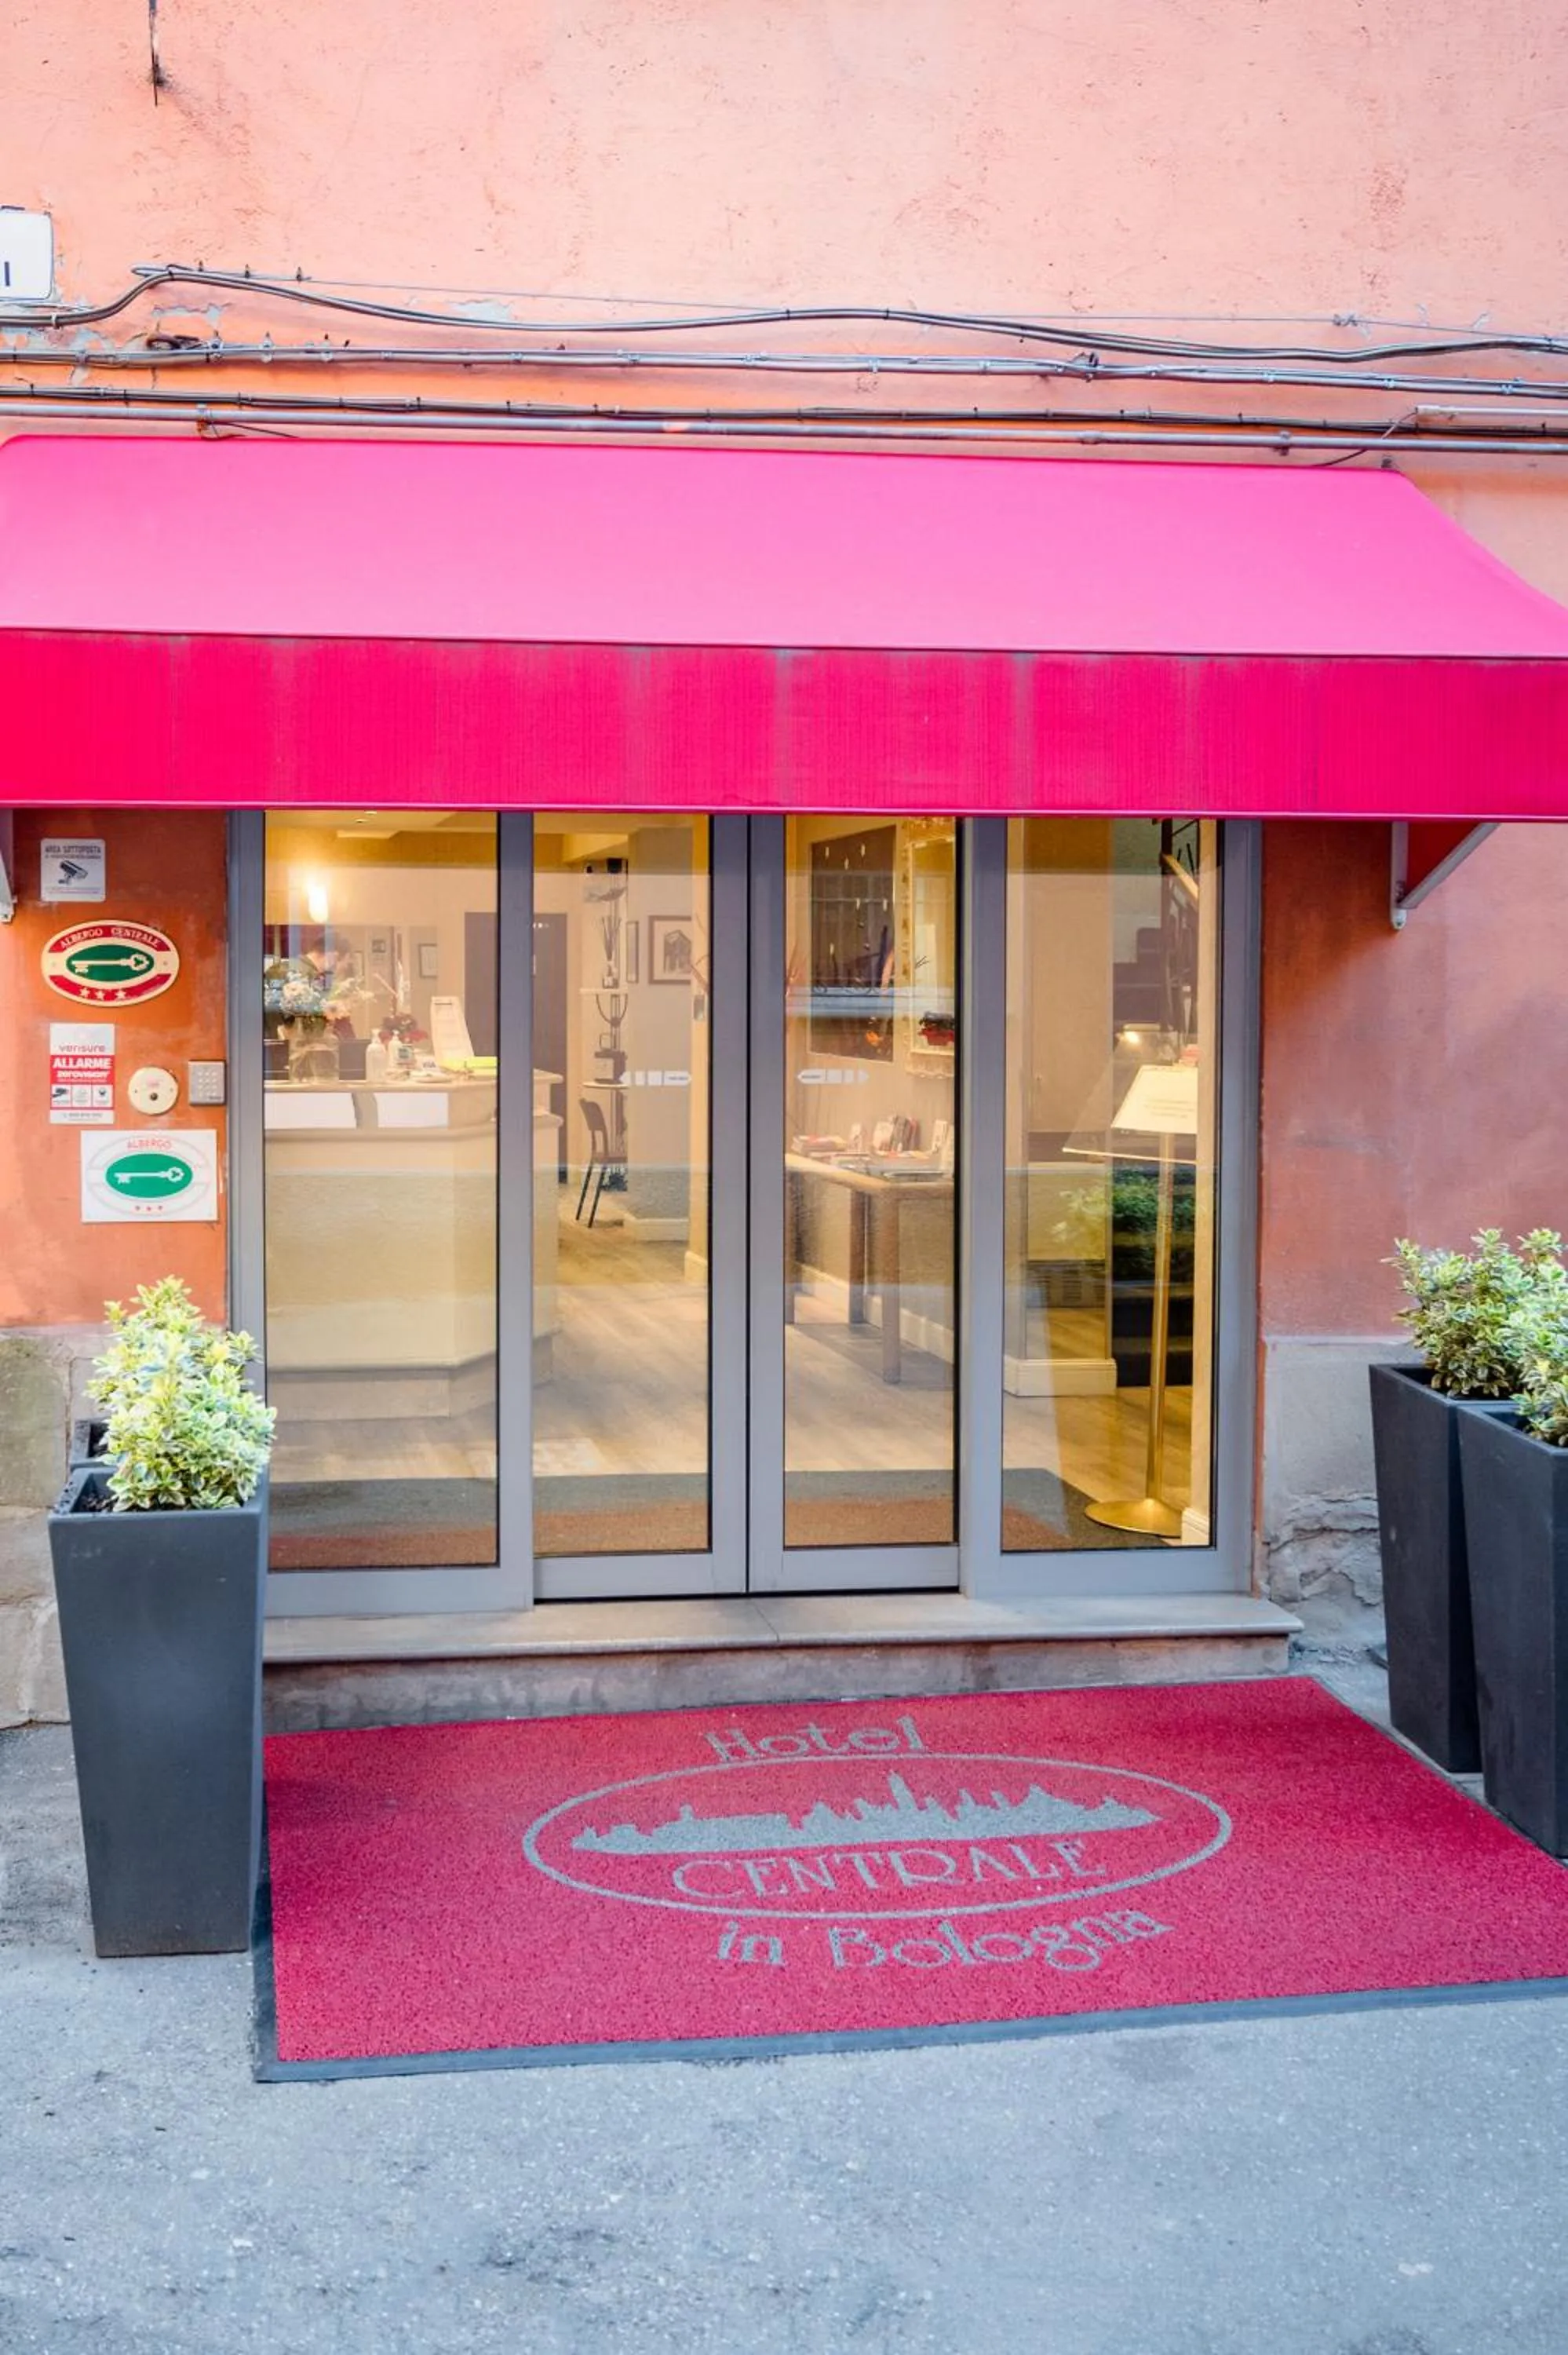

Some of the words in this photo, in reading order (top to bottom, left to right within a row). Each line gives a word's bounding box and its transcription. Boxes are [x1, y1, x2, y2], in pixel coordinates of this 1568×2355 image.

[60, 927, 104, 949] ALBERGO
[111, 927, 159, 947] CENTRALE
[53, 1057, 113, 1069] ALLARME
[127, 1139, 172, 1149] ALBERGO
[705, 1715, 924, 1760] Hotel
[672, 1839, 1105, 1899] CENTRALE
[717, 1921, 782, 1965] in
[827, 1908, 1173, 1972] Bologna
